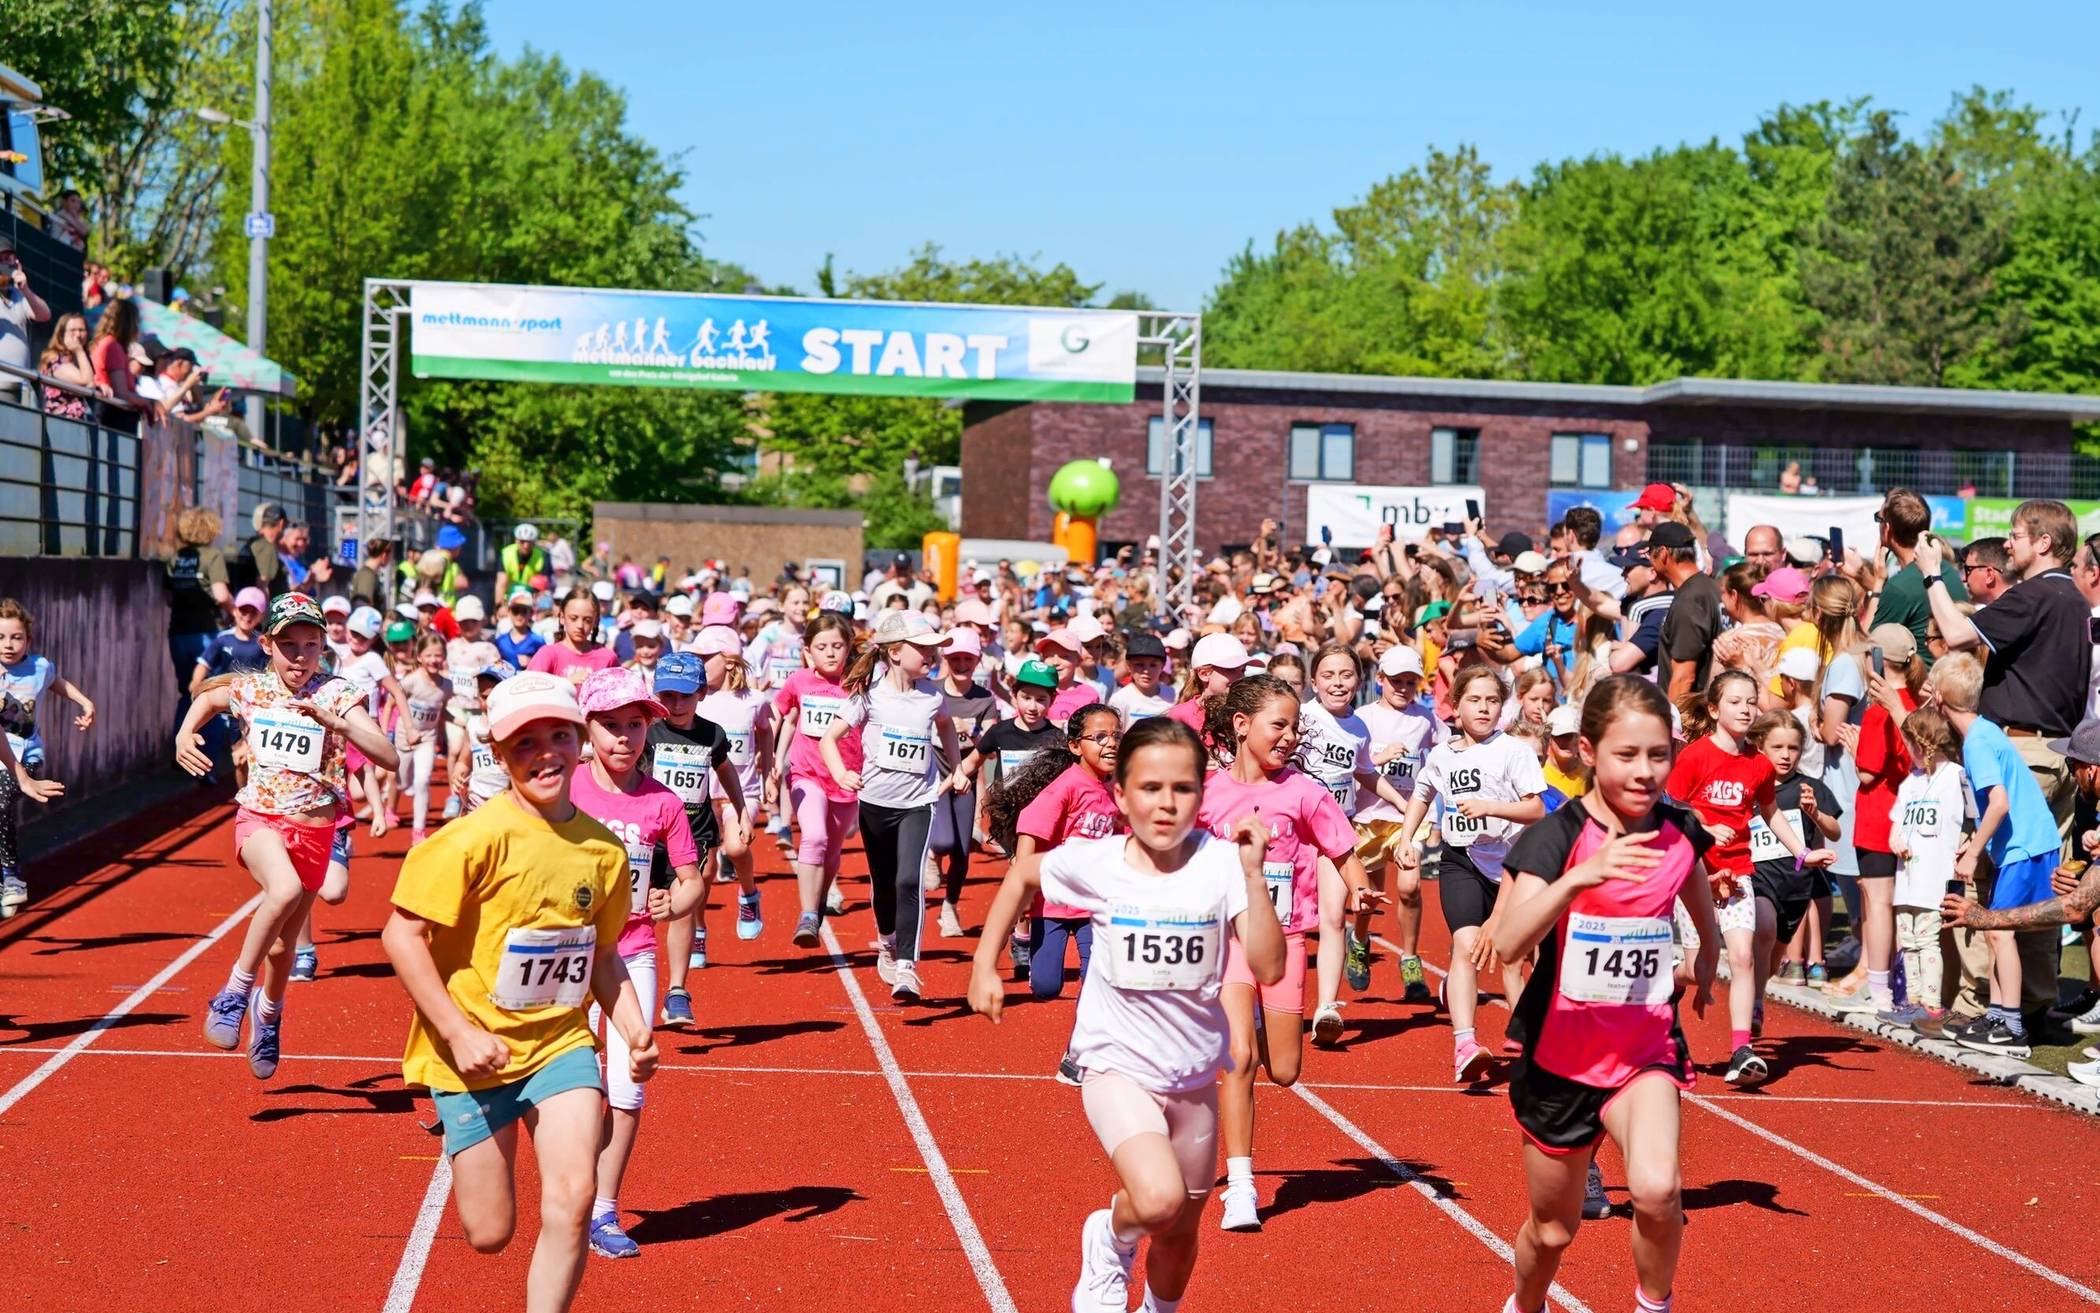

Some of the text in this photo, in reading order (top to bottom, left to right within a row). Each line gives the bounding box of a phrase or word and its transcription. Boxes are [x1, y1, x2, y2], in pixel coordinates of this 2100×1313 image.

[800, 327, 1009, 380] START
[806, 710, 837, 725] 147
[260, 729, 311, 755] 1479
[888, 741, 926, 760] 1671
[1325, 742, 1355, 769] KGS
[664, 769, 705, 789] 1657
[1450, 768, 1481, 792] KGS
[1711, 780, 1744, 806] KGS
[1449, 815, 1488, 832] 1601
[1903, 807, 1937, 826] 2103
[1753, 831, 1779, 848] 15
[630, 869, 640, 893] 2
[1269, 885, 1279, 906] 1
[1578, 921, 1606, 932] 2025
[1123, 933, 1205, 964] 1536
[520, 956, 588, 986] 1743
[1585, 948, 1659, 979] 1435
